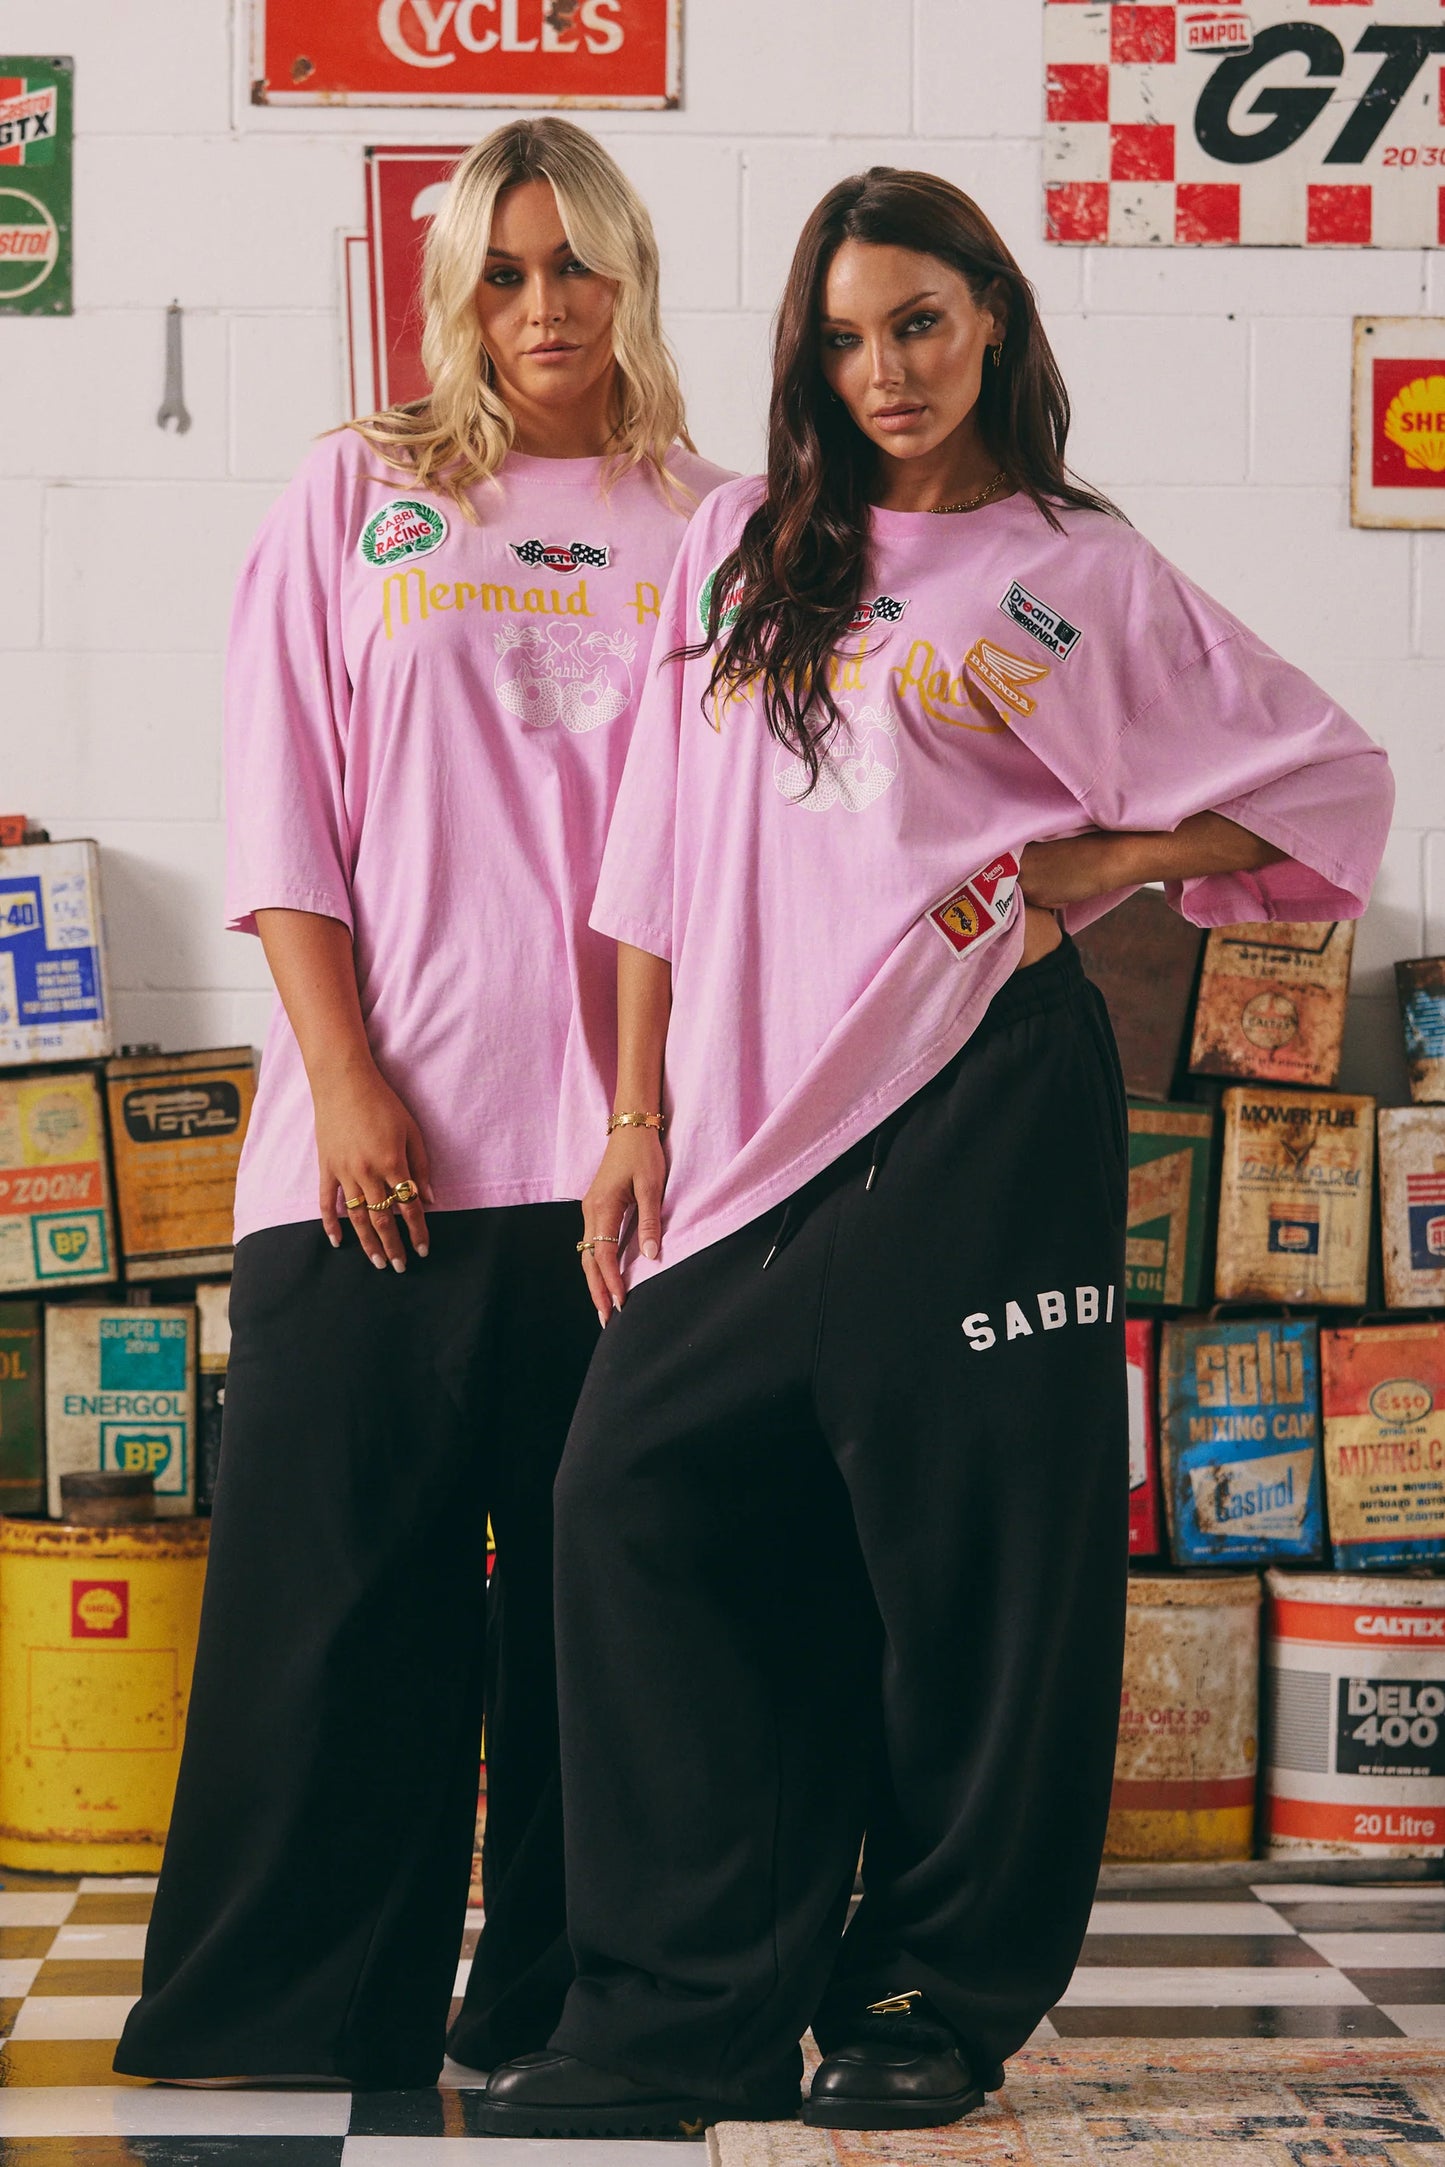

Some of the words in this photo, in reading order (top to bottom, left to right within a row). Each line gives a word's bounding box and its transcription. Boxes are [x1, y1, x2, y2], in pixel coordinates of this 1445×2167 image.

[378, 0, 625, 68] CYCLES
[1188, 23, 1248, 46] AMPOL
[1193, 22, 1445, 165] GT
[375, 509, 415, 536] SABBI
[375, 521, 432, 557] RACING
[382, 566, 598, 640] Mermaid
[1009, 587, 1055, 631] Dream
[1019, 614, 1060, 651] BRENDA
[969, 652, 1031, 712] BRENDA
[1240, 1104, 1313, 1126] MOWER
[1317, 1107, 1360, 1129] FUEL
[11, 1169, 93, 1205] ZOOM
[54, 1231, 87, 1255] BP
[101, 1320, 155, 1338] SUPER
[961, 1284, 1115, 1352] SABBI
[63, 1395, 187, 1417] ENERGOL
[1189, 1415, 1267, 1442] MIXING
[1272, 1413, 1316, 1440] CAN
[122, 1442, 169, 1471] BP
[1338, 1440, 1422, 1477] MIXING
[1214, 1465, 1294, 1523] Castrol
[1354, 1614, 1445, 1637] CALTEX
[1347, 1684, 1445, 1717] DELO
[1352, 1715, 1438, 1747] 400
[1353, 1814, 1384, 1835] 20
[1385, 1814, 1436, 1838] Litre
